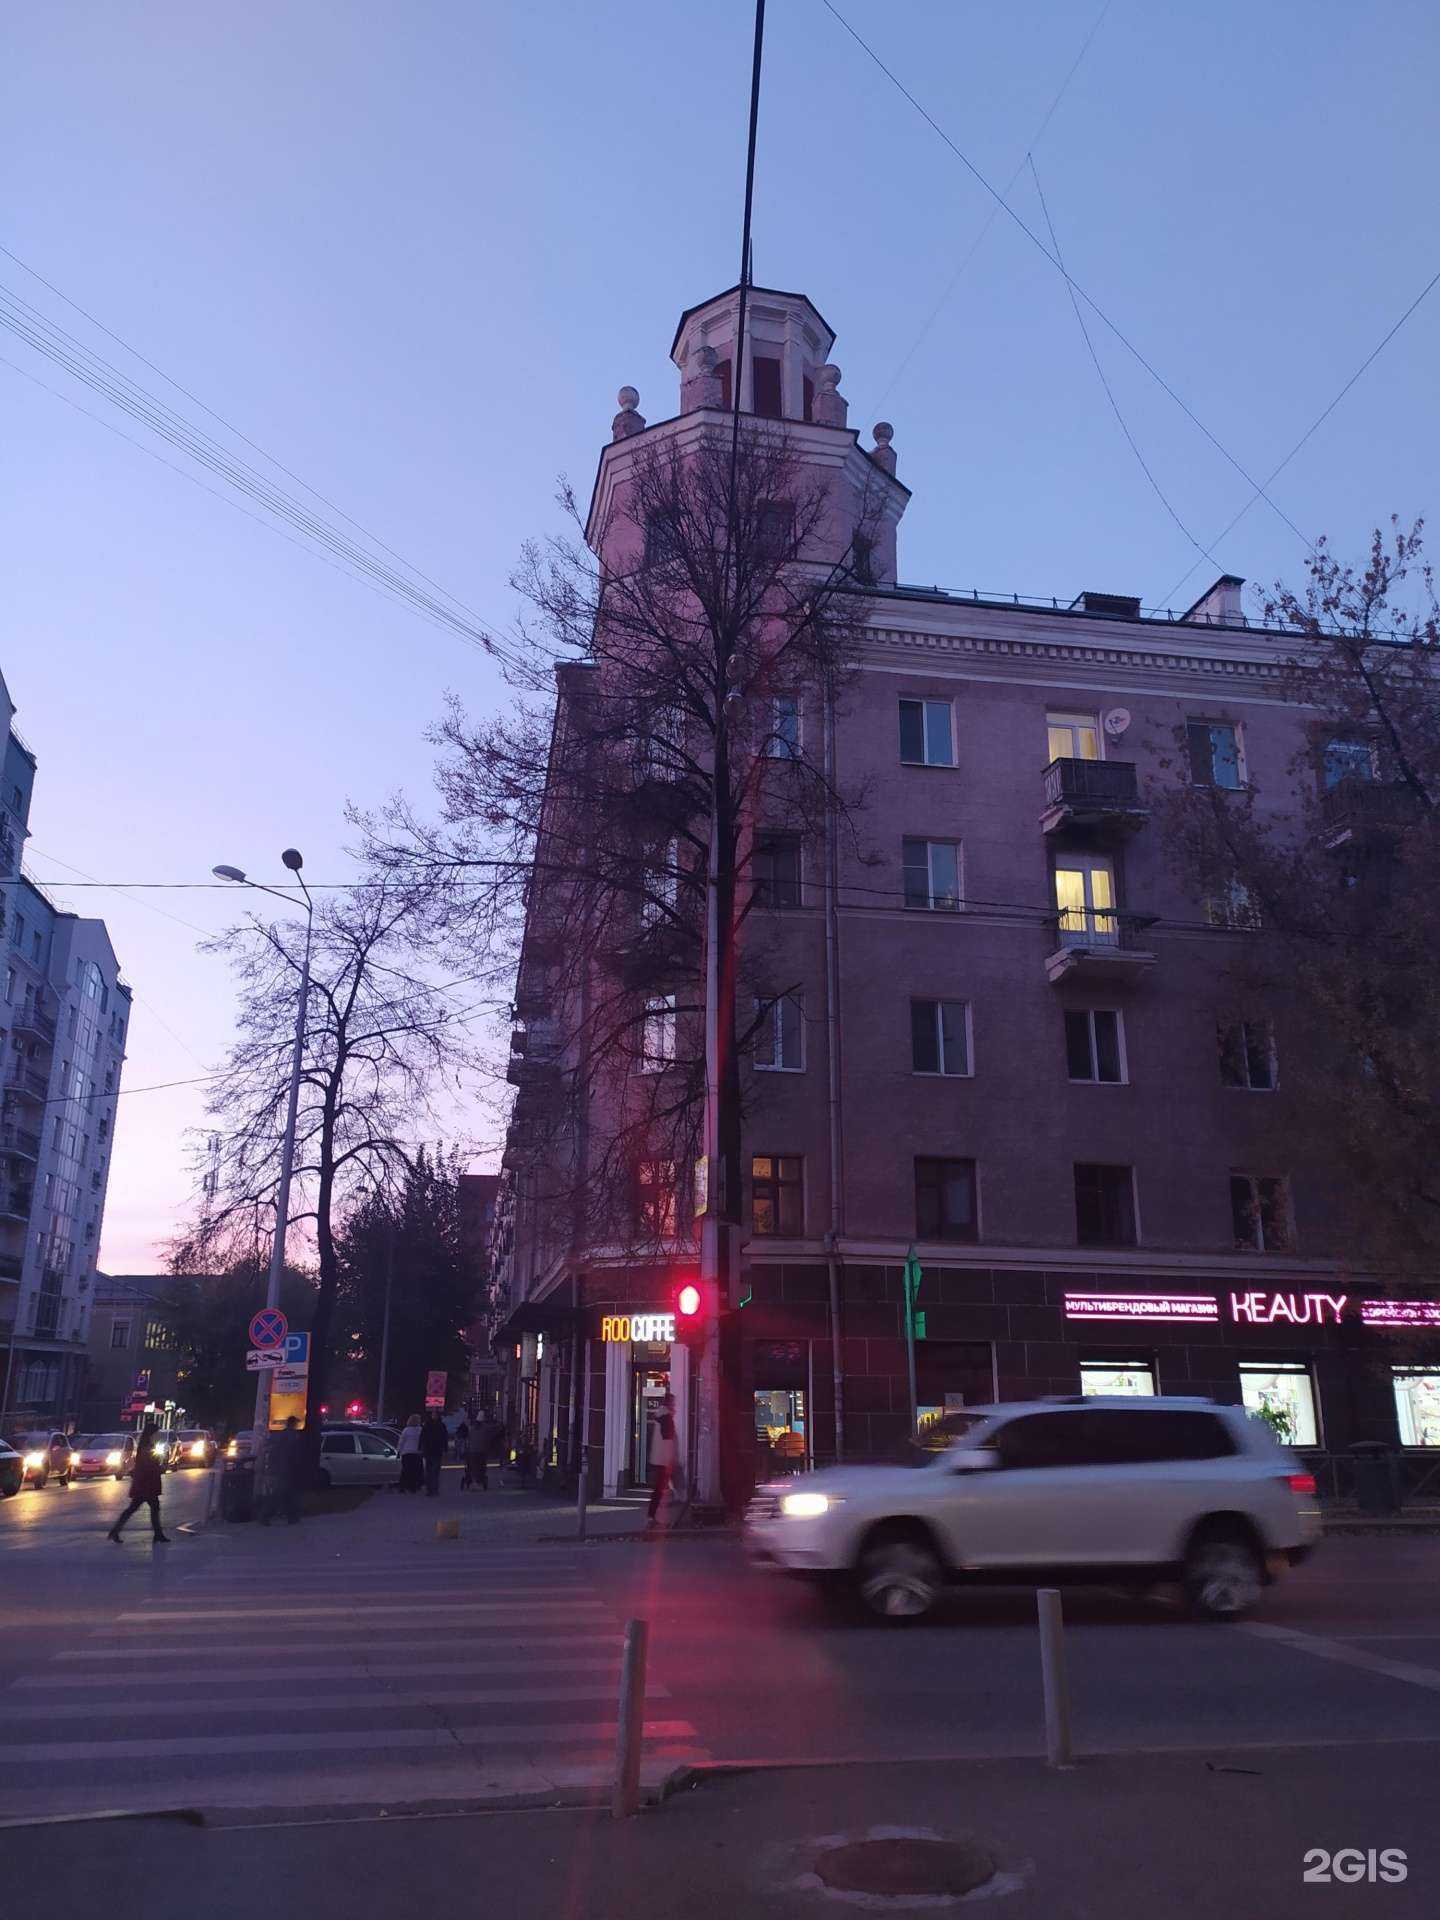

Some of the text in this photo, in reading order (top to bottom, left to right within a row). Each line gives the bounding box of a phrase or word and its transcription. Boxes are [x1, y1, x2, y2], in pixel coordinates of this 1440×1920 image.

[1065, 1301, 1218, 1314] МУЛЬТИБРЕНДОВЫЙ МАГАЗИН
[1231, 1292, 1347, 1324] KEAUTY
